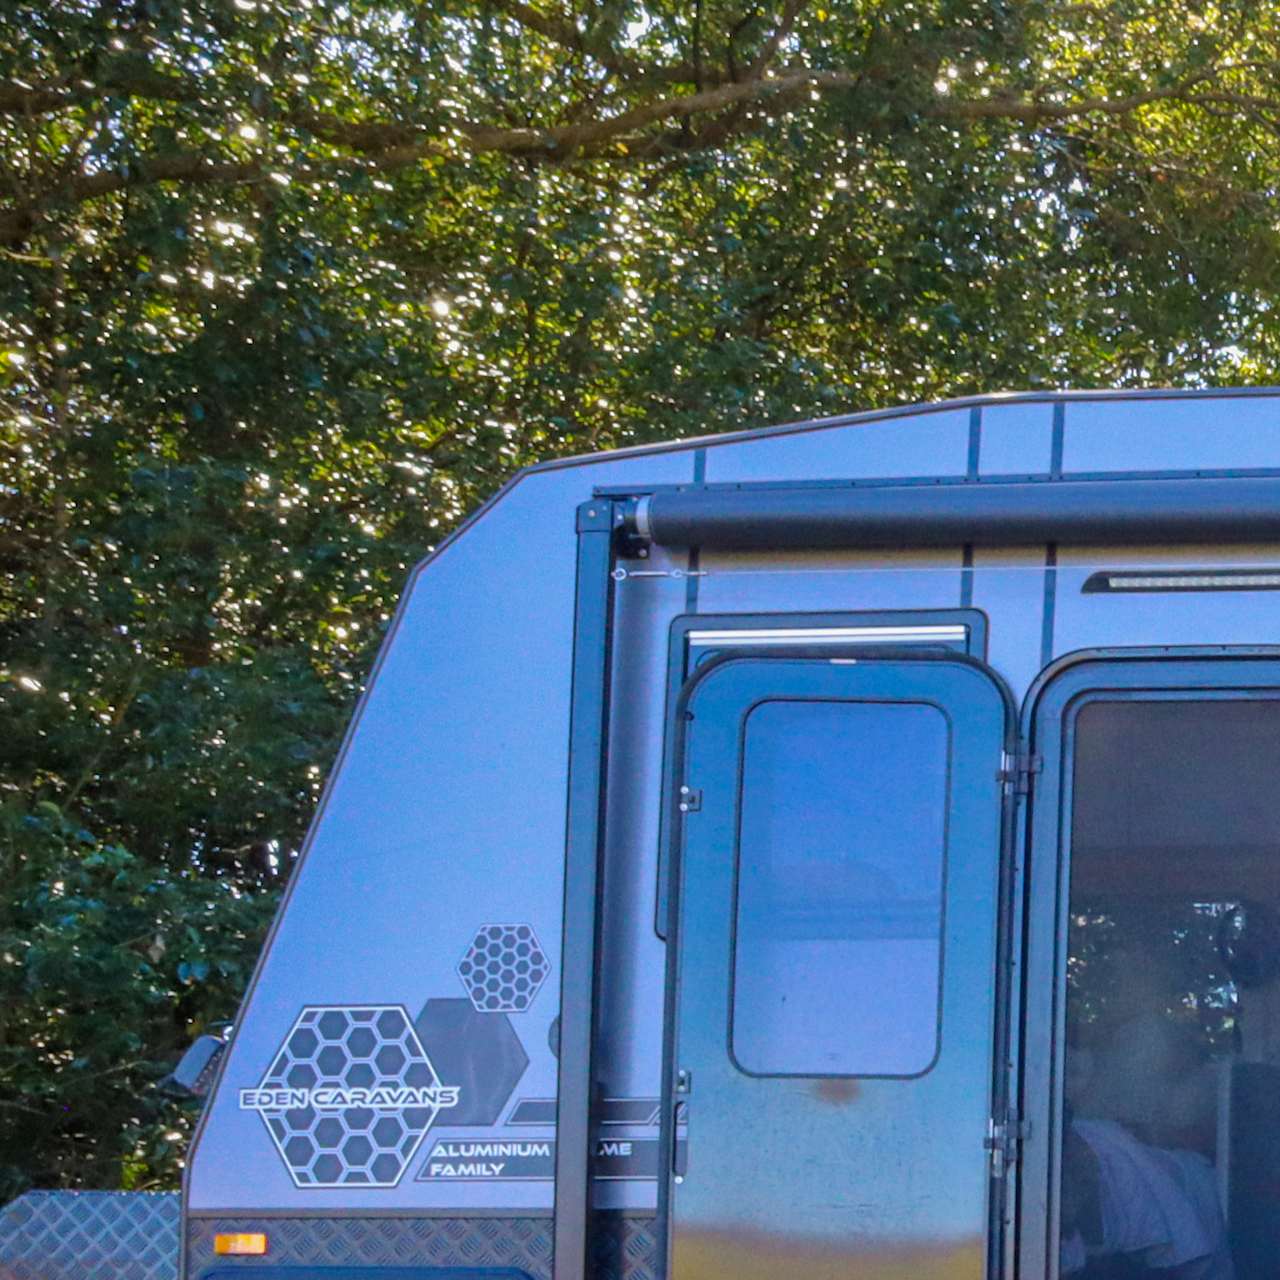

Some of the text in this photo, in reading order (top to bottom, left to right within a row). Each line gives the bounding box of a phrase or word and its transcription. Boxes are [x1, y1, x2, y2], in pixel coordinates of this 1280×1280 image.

[240, 1087, 460, 1108] EDEN CARAVANS
[431, 1143, 550, 1157] ALUMINIUM
[430, 1163, 504, 1176] FAMILY
